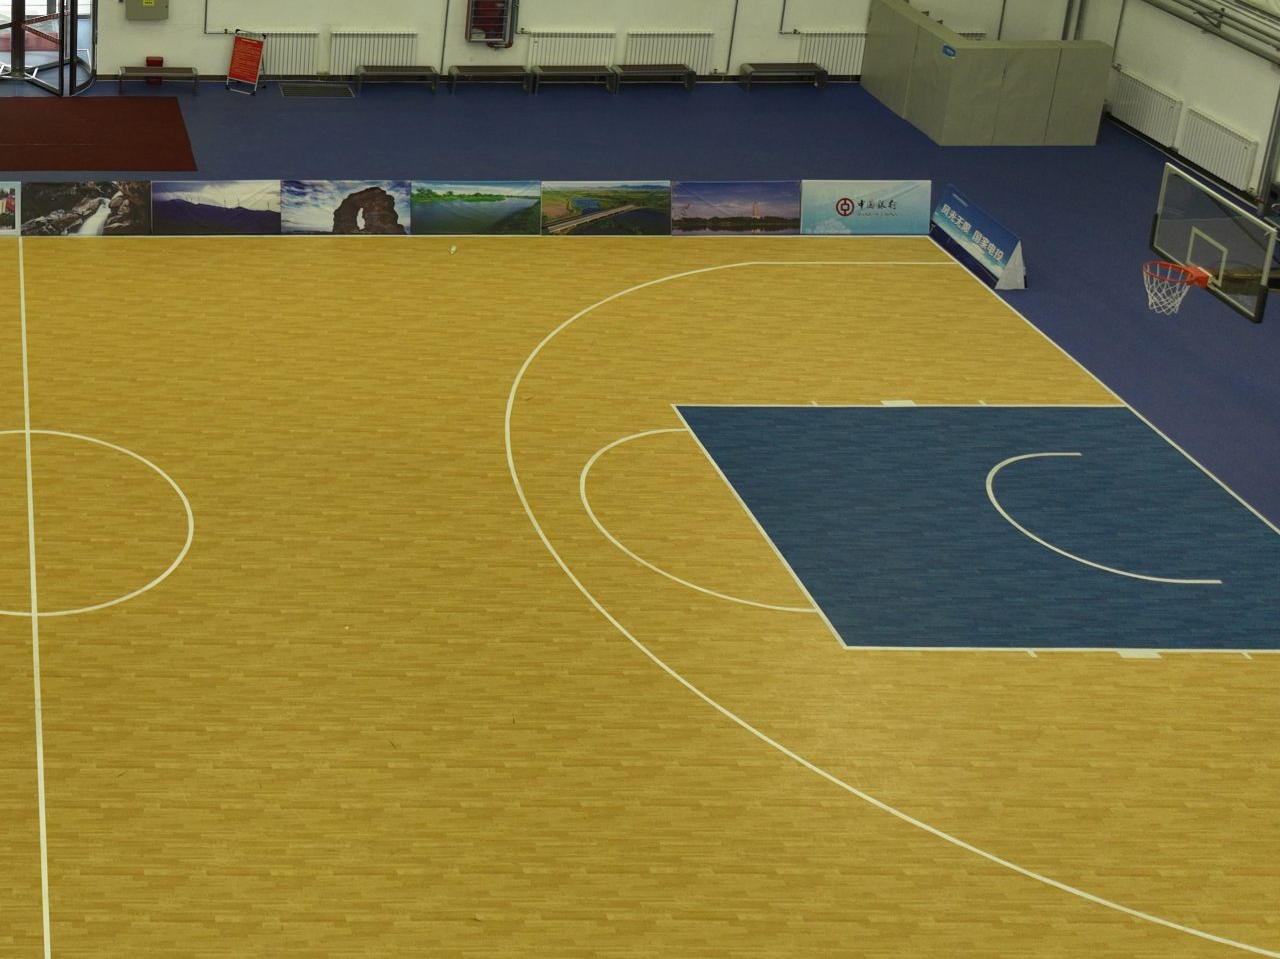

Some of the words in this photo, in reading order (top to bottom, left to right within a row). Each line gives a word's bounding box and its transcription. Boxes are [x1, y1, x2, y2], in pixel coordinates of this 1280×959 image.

[857, 199, 897, 210] 中国银行
[941, 204, 971, 233] 风光无限
[972, 230, 1004, 260] 国家电投
